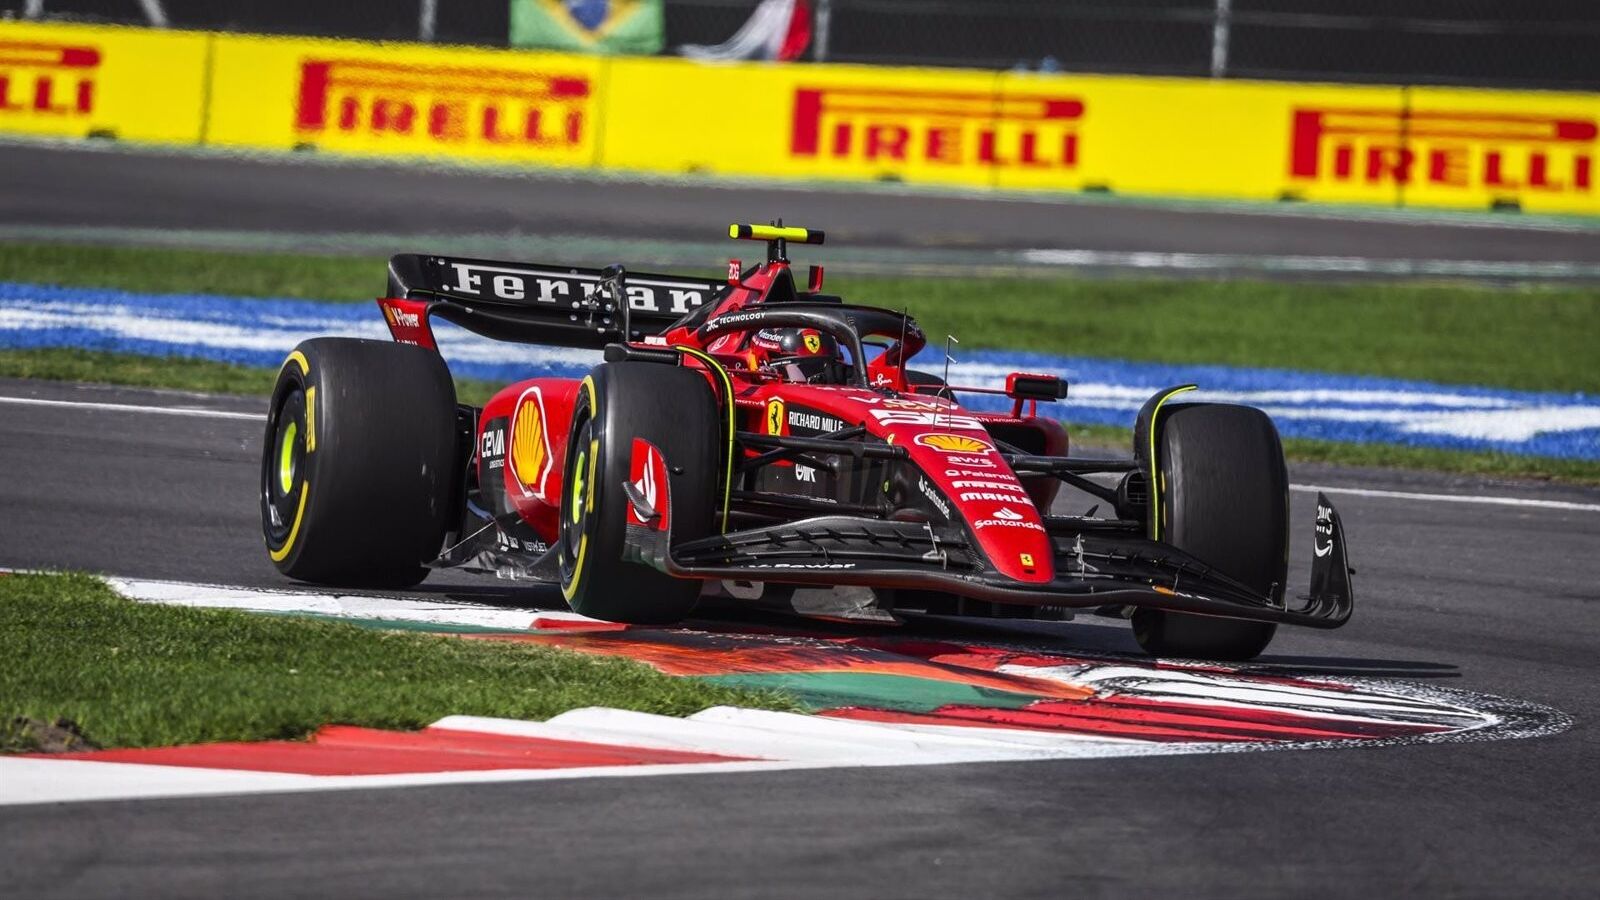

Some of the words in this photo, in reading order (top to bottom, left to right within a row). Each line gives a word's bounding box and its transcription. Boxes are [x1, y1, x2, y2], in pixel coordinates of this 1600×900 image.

[294, 60, 591, 145] PIRELLI
[788, 86, 1086, 169] PIRELLI
[1288, 107, 1599, 192] PIRELLI
[452, 262, 726, 314] Ferrar
[719, 312, 766, 325] TECHNOLOGY
[788, 411, 821, 430] RICHARD
[821, 417, 844, 433] MILLE
[481, 429, 505, 458] CEVA
[946, 455, 994, 466] aws
[960, 492, 1035, 507] MAHLE
